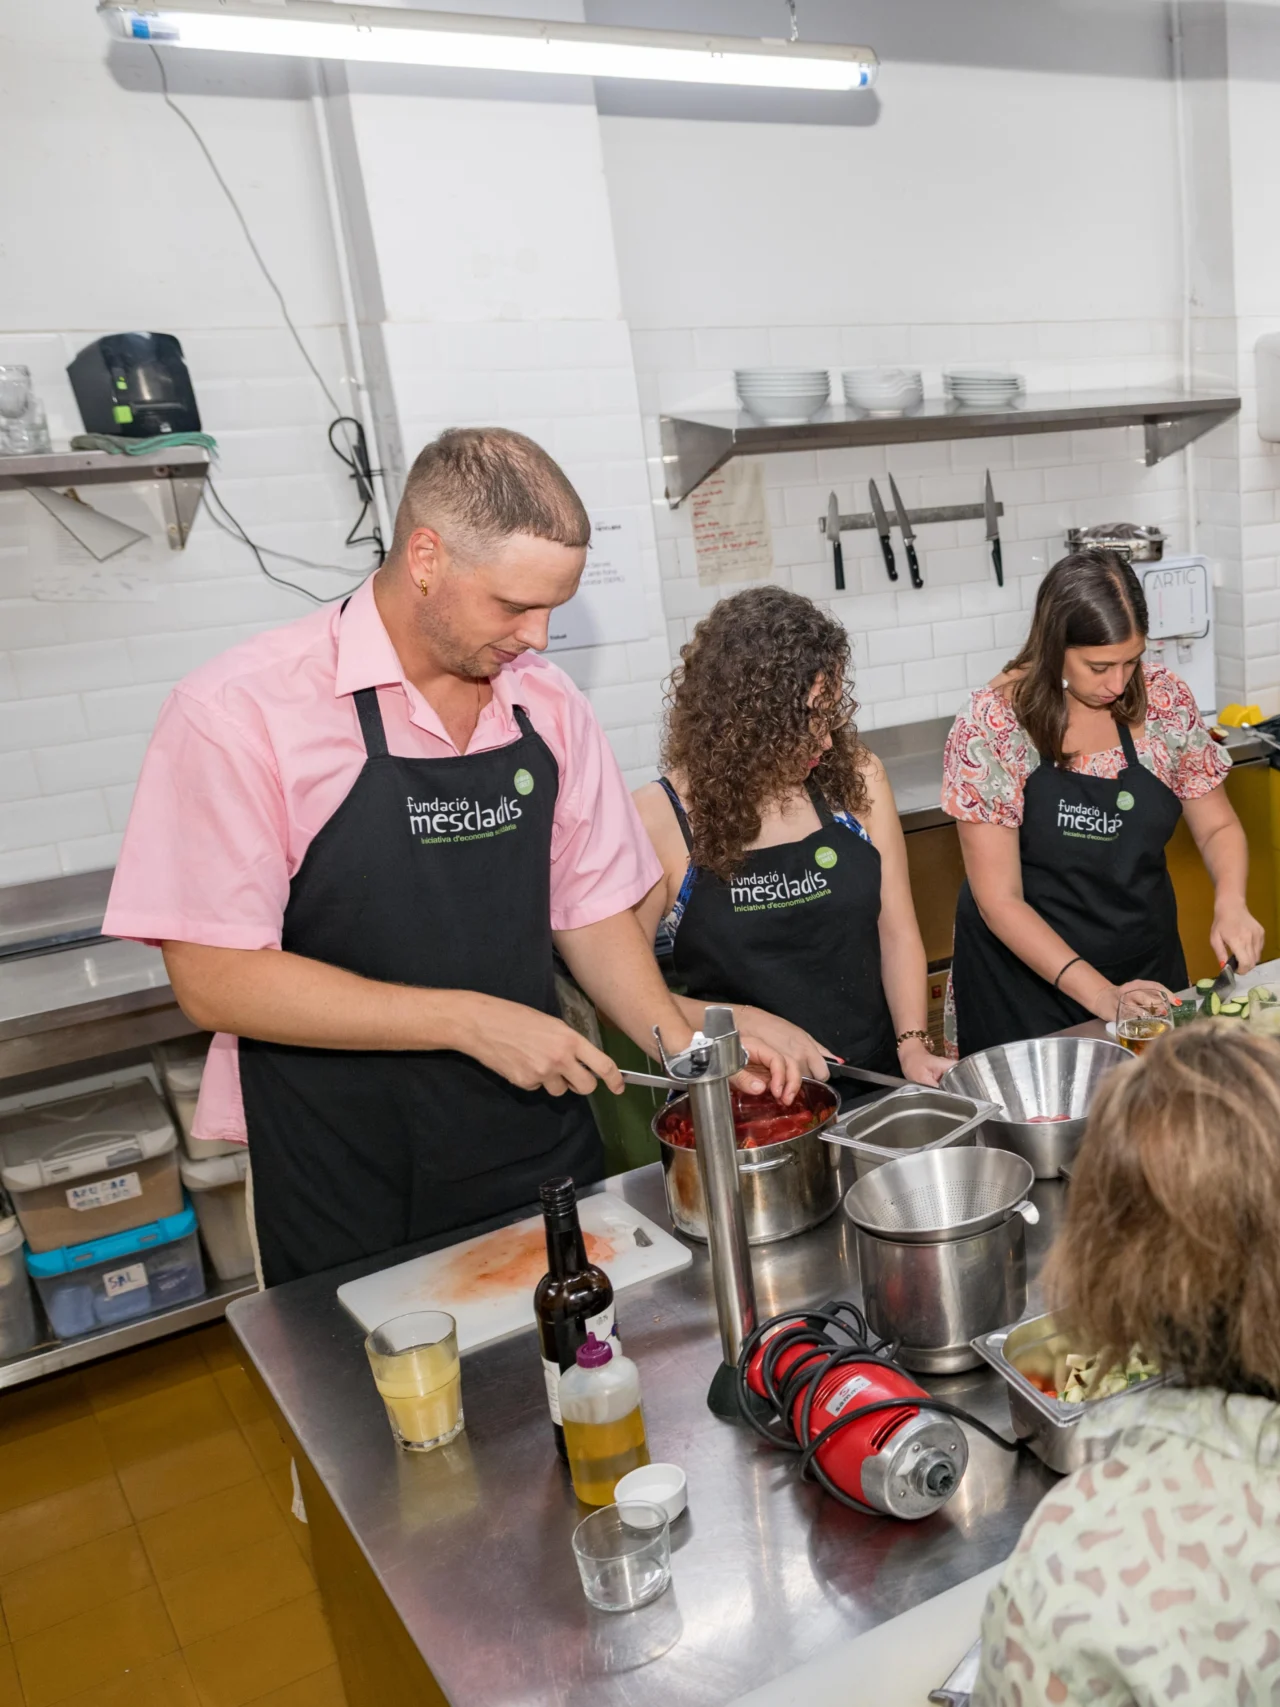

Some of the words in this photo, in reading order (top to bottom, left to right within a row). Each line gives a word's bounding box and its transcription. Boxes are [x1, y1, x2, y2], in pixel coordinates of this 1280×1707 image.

[1153, 569, 1196, 590] ARTIC
[409, 795, 522, 835] mescladis
[731, 869, 827, 904] mescladis
[734, 904, 765, 912] Iniciativa
[767, 898, 805, 909] d'economia
[108, 1271, 137, 1290] SAL
